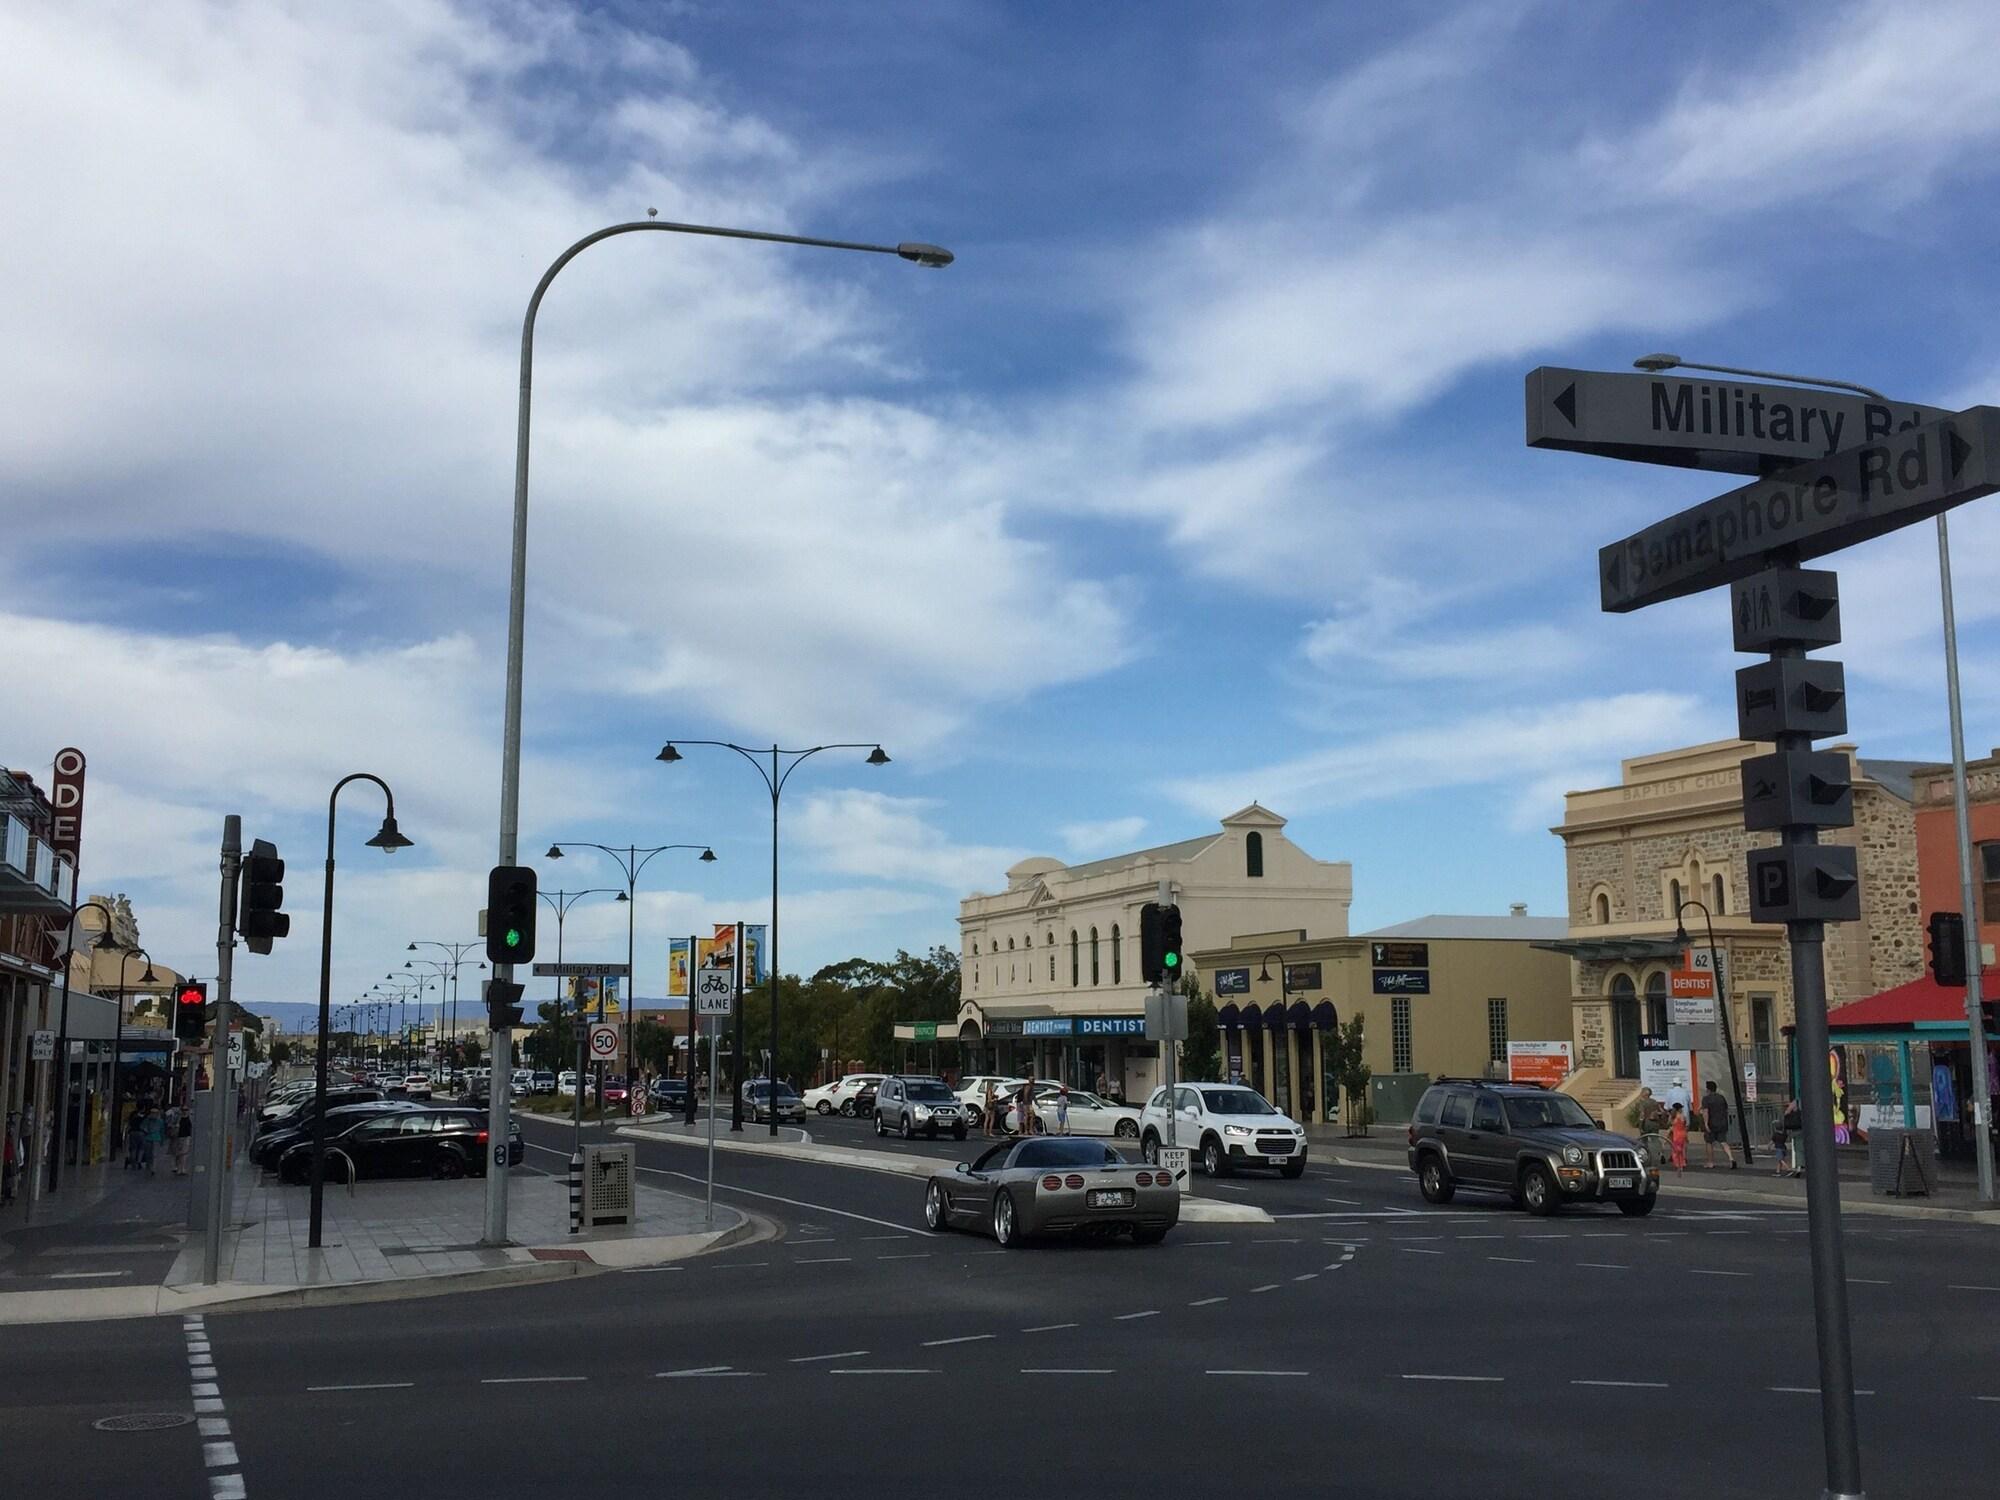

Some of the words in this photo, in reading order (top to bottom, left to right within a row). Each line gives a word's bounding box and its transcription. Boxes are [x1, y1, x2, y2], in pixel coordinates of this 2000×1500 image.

[1651, 381, 1845, 454] Military
[1628, 475, 1838, 584] Semaphore
[1859, 427, 1929, 502] Rd
[1623, 780, 1688, 801] BAPTIST
[1763, 866, 1783, 903] P
[1695, 954, 1708, 967] 62
[553, 964, 593, 976] Military
[596, 964, 610, 974] Rd
[1673, 978, 1711, 989] DENTIST
[700, 999, 729, 1010] LANE
[1083, 1019, 1145, 1033] DENTIST
[595, 1035, 614, 1048] 50
[33, 1049, 52, 1057] ONLY
[1652, 1059, 1662, 1067] For
[1663, 1059, 1680, 1067] Lease
[1164, 1151, 1185, 1159] KEEP
